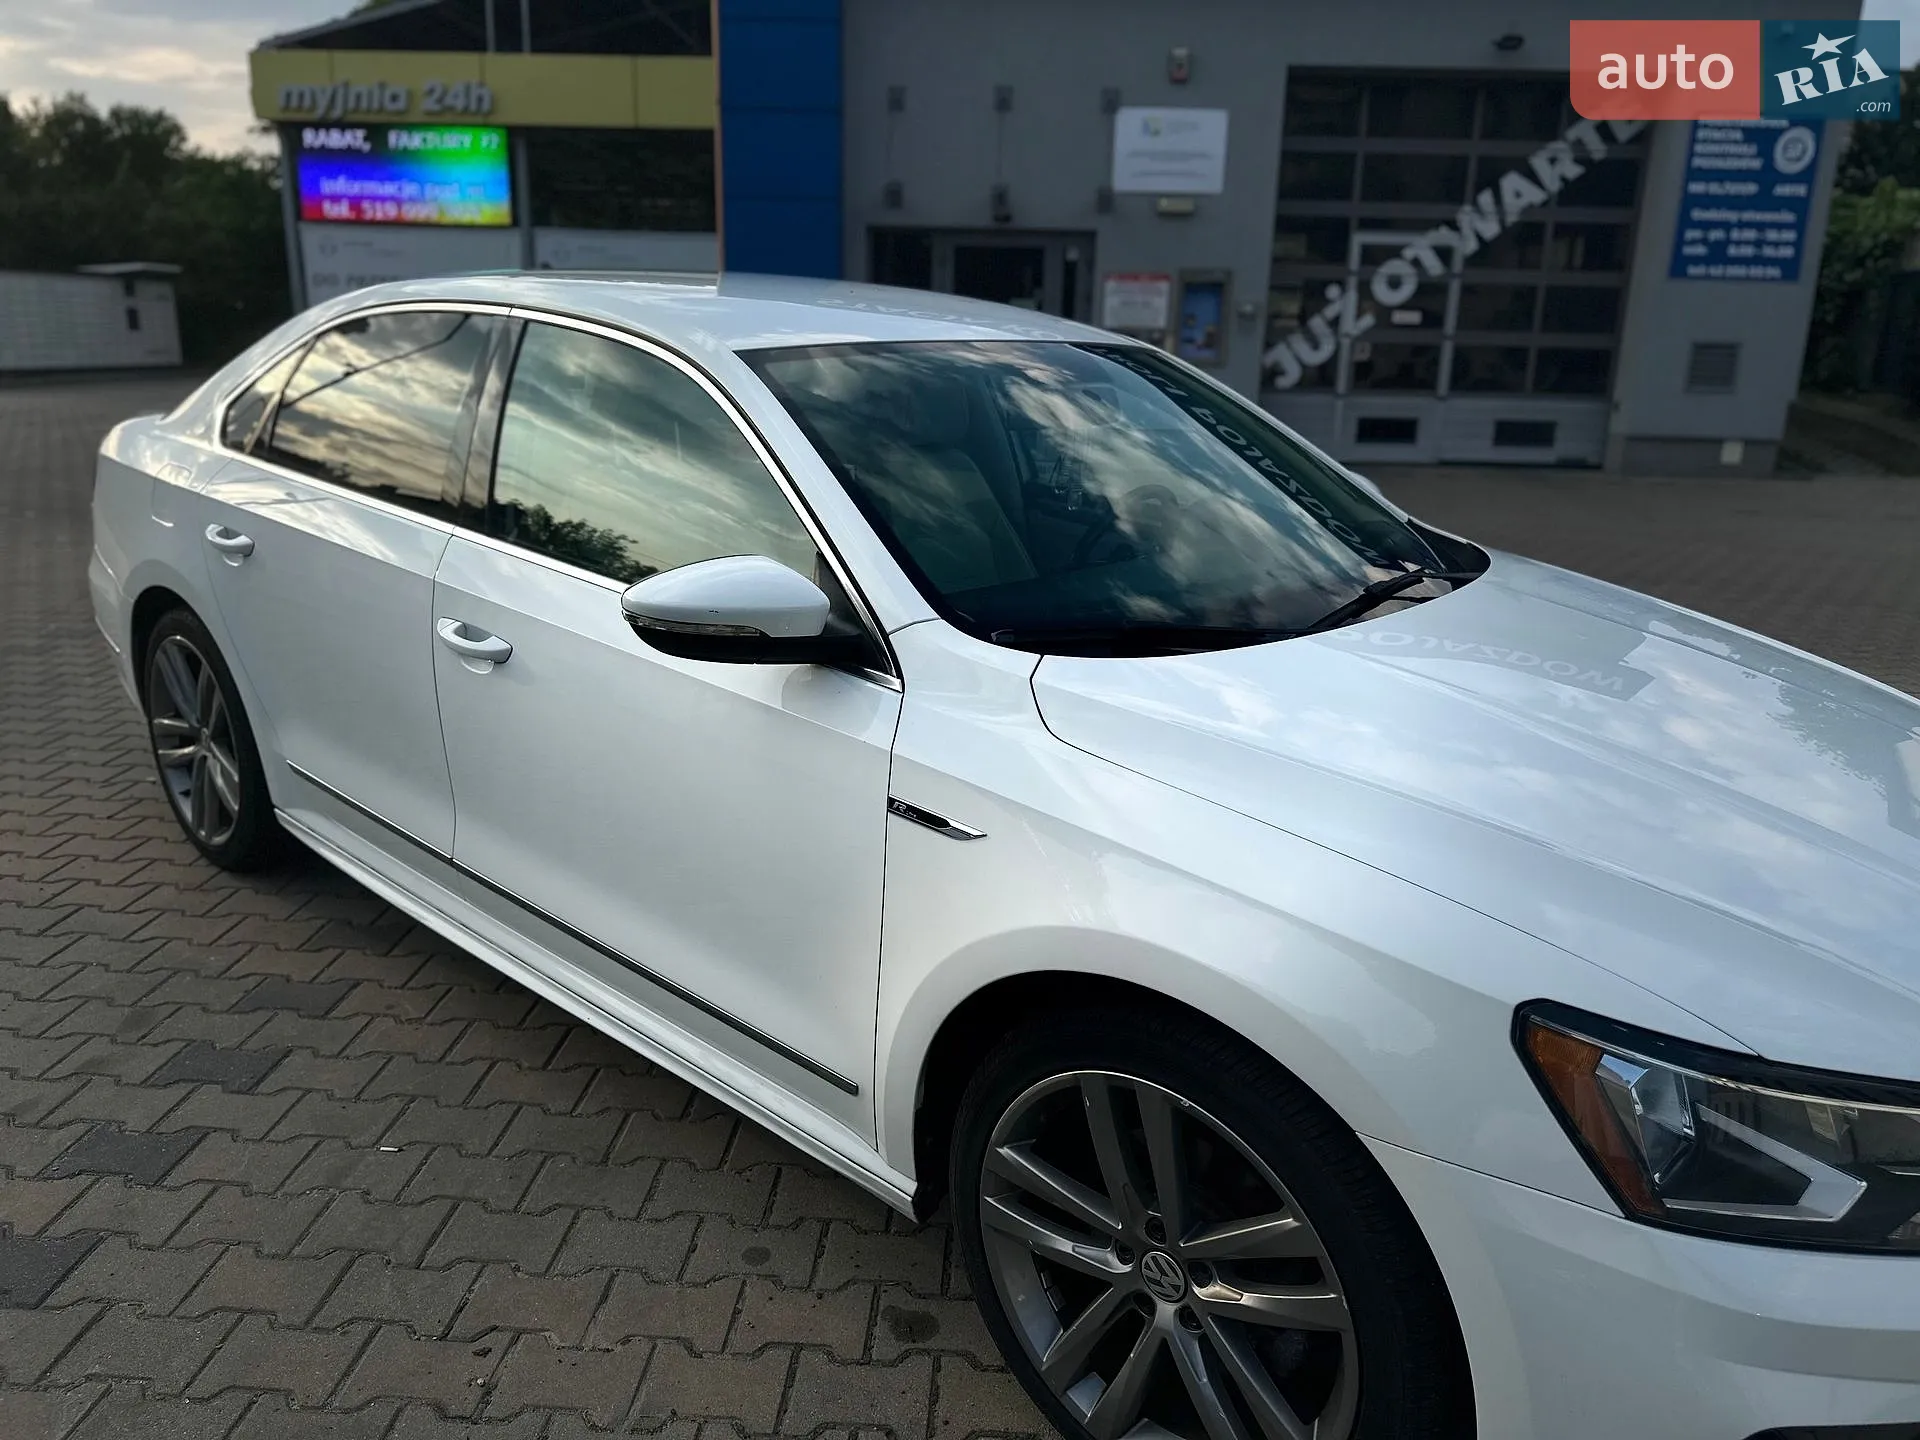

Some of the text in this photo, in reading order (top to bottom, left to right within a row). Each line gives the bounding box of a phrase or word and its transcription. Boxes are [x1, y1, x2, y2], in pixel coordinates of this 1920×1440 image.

[278, 79, 494, 122] myjnia 24h
[1263, 281, 1376, 390] JUŻ
